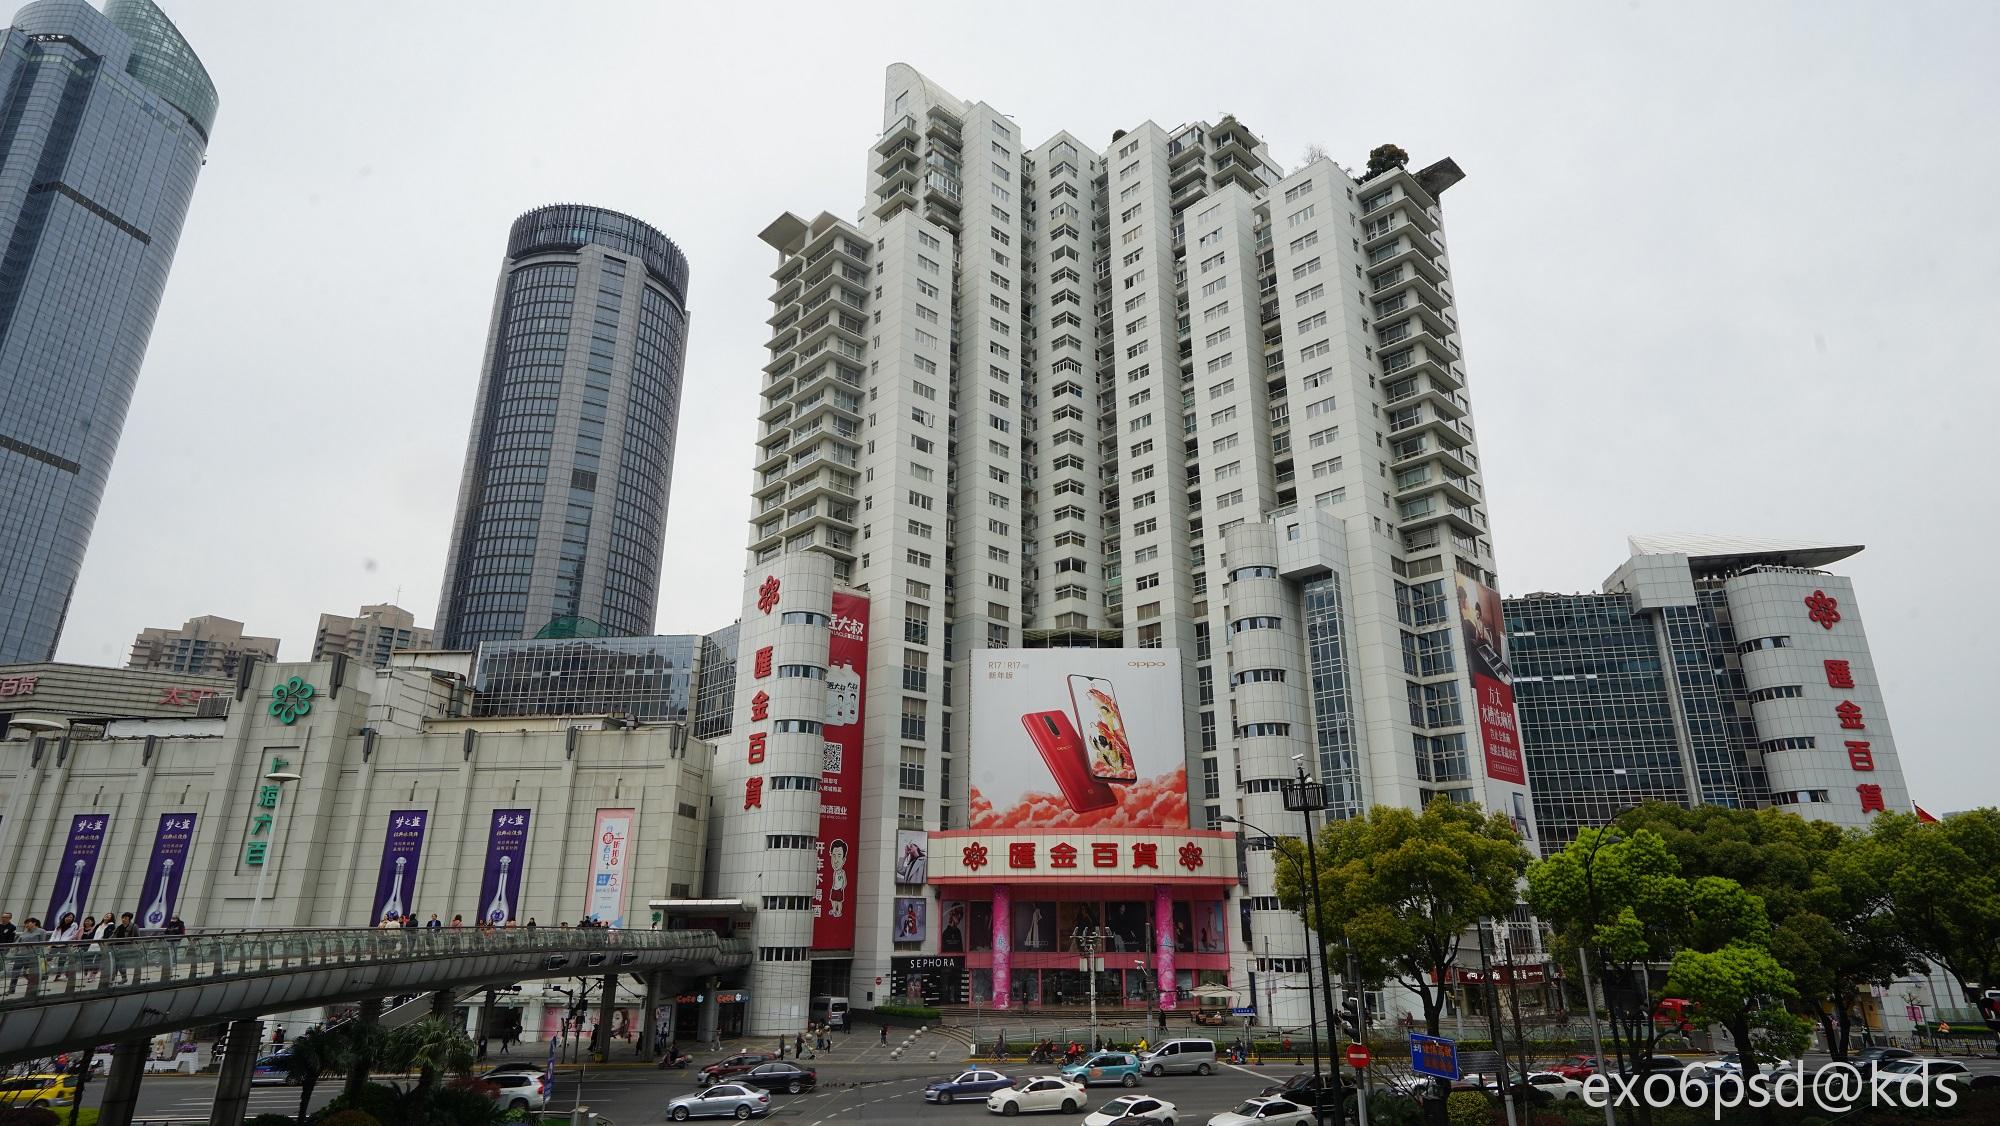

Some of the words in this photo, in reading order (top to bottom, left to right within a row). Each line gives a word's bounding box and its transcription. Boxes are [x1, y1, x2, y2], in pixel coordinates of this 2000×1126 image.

[744, 645, 773, 810] 匯金百貨
[1824, 659, 1885, 814] 匯金百貨
[1009, 842, 1159, 869] 匯金百貨
[910, 958, 955, 969] SEPHORA
